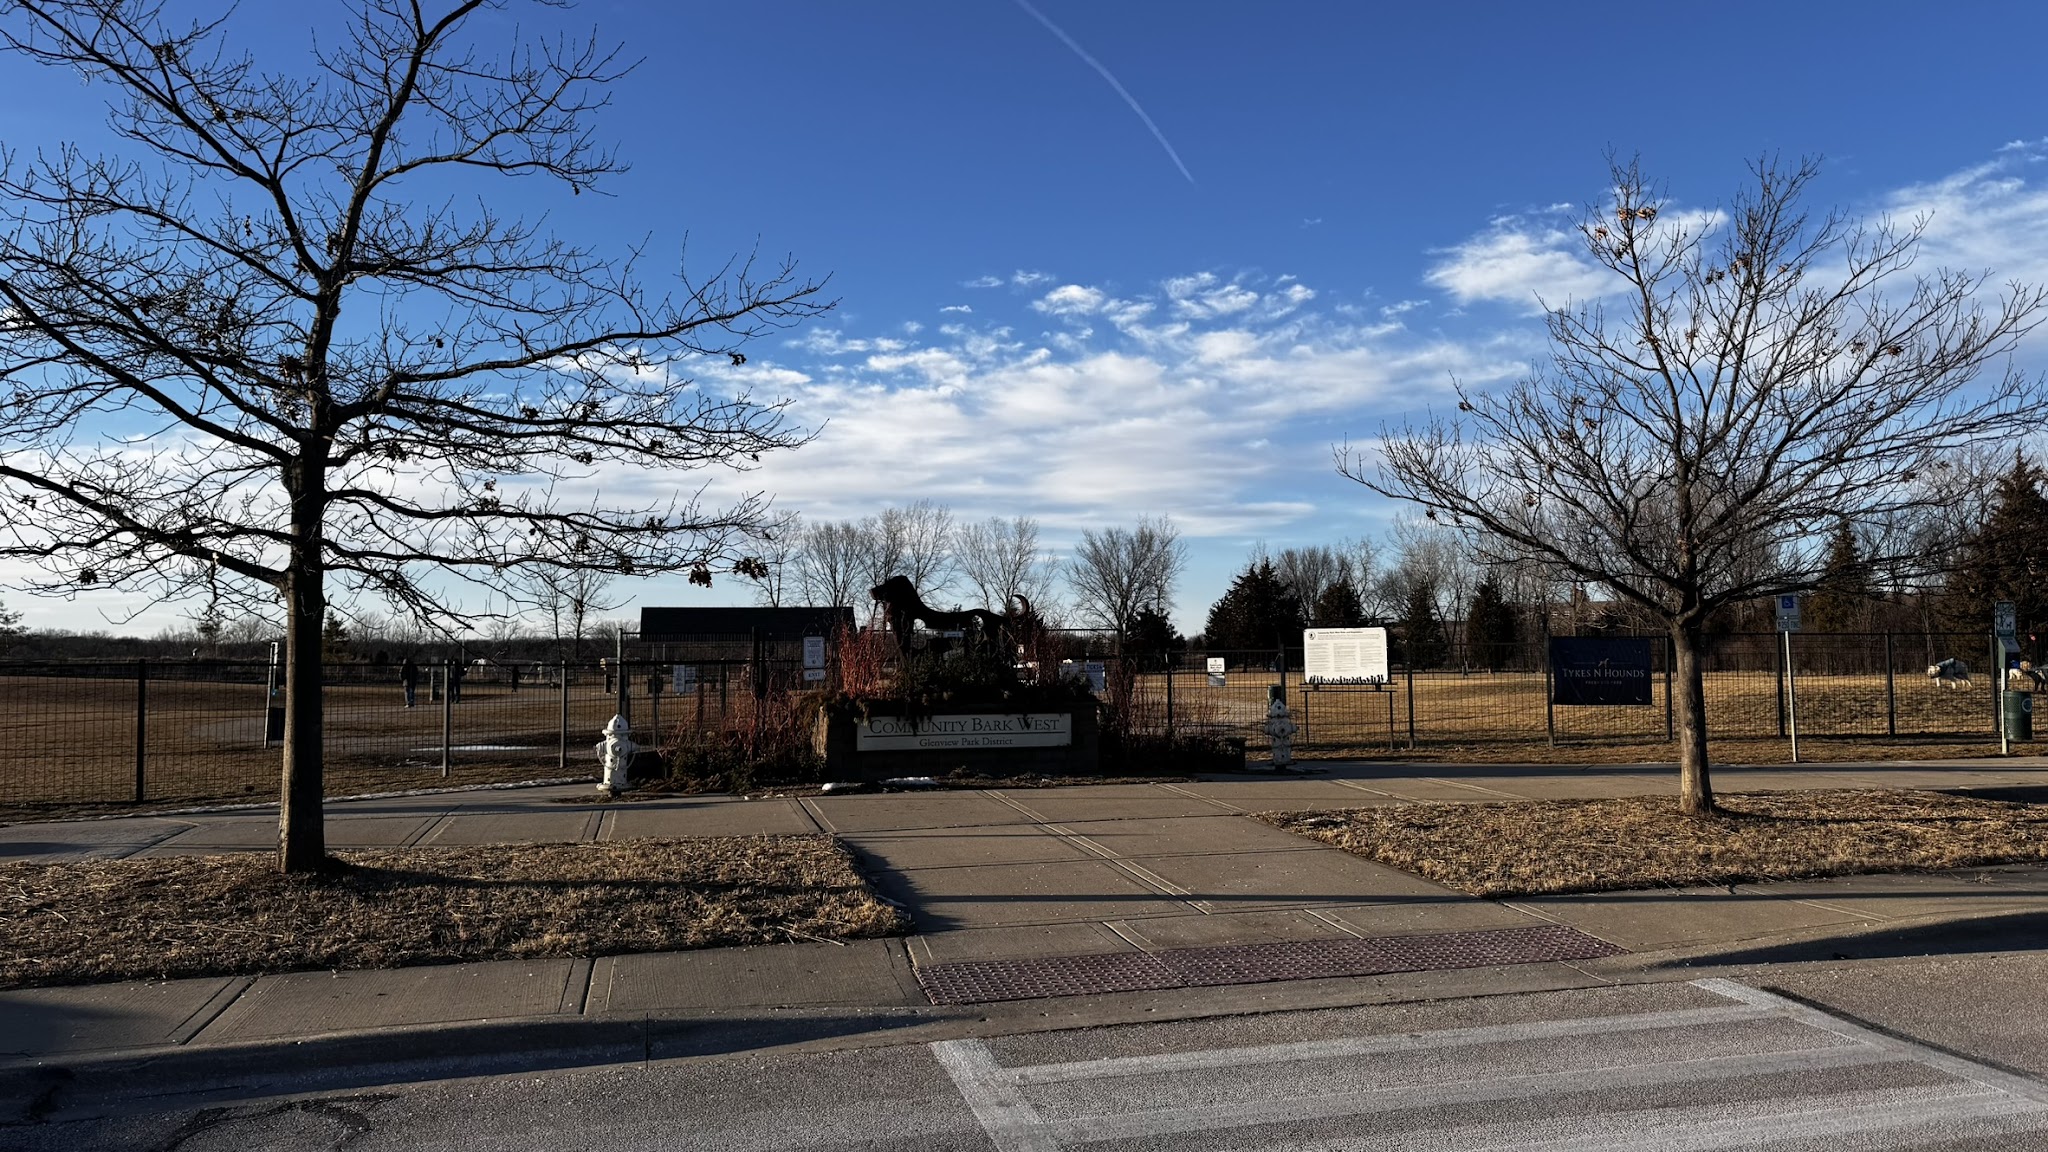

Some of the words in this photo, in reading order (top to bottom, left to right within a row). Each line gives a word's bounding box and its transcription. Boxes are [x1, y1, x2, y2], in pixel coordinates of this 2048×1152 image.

[1562, 668, 1591, 678] TYKES
[1594, 668, 1602, 678] N
[1605, 668, 1645, 678] HOUNDS
[971, 717, 1013, 732] BARK
[1017, 716, 1060, 731] WEST
[919, 737, 959, 747] Glenview
[961, 736, 980, 746] Park
[982, 735, 1013, 746] District
